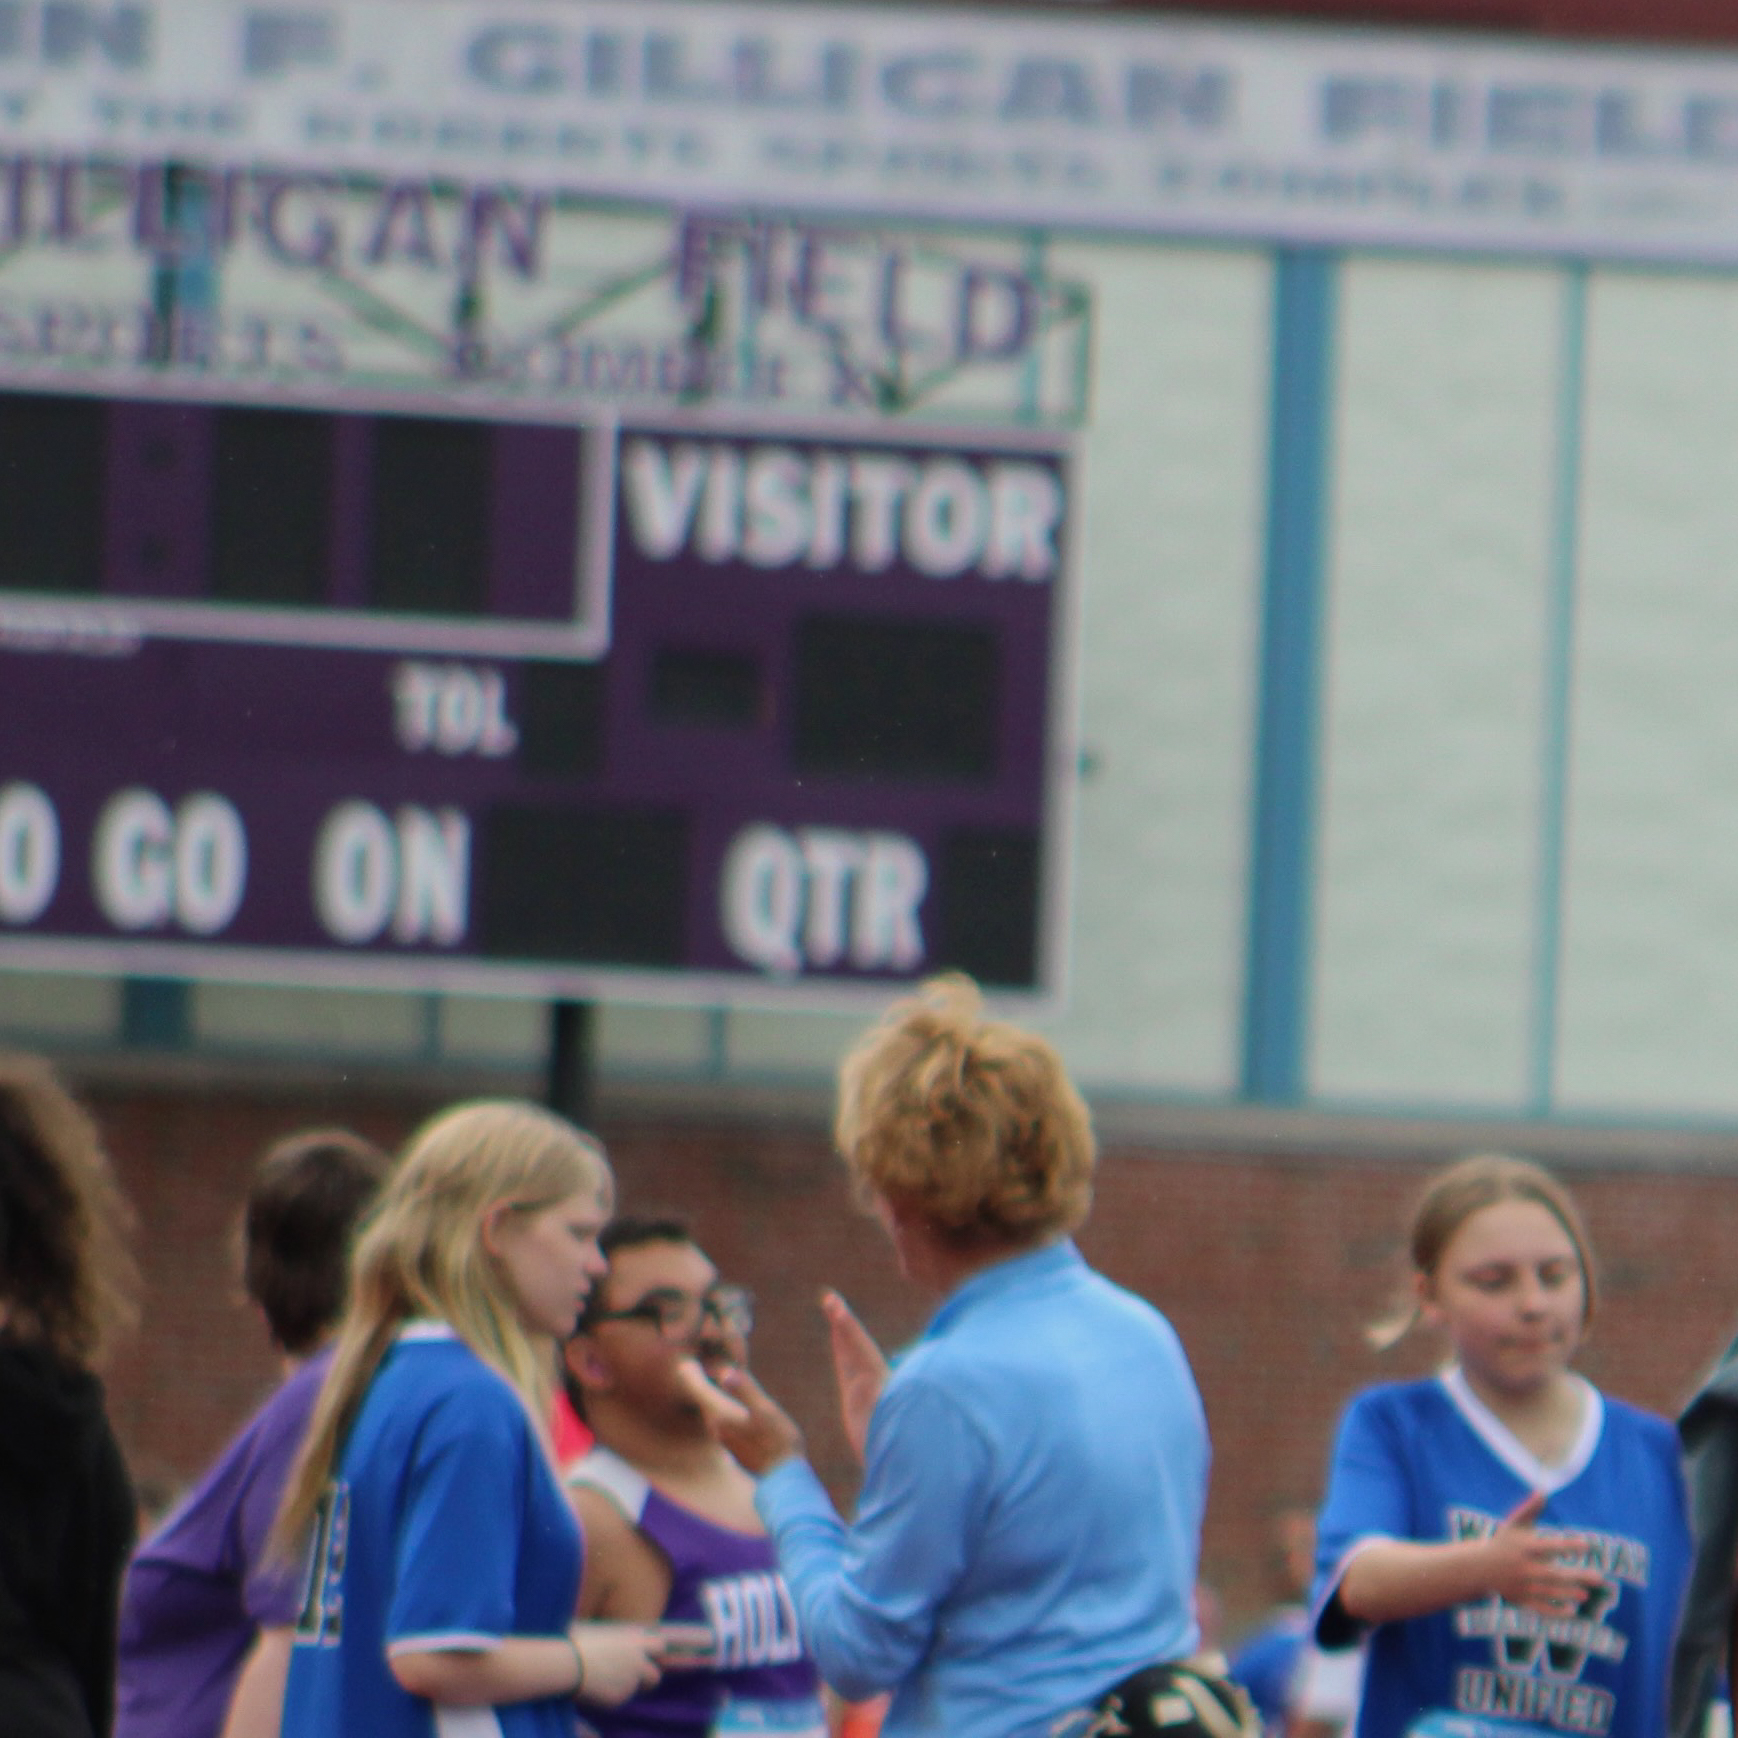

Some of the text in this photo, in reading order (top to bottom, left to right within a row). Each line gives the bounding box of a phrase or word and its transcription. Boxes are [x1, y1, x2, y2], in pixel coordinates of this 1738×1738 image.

[464, 20, 1235, 130] GILLIGAN
[676, 210, 1042, 364] FIELD
[623, 440, 1066, 582] VISITOR
[394, 661, 518, 758] TOL
[93, 788, 248, 938] GO
[313, 797, 472, 948] ON
[720, 822, 930, 982] QTR
[1455, 1665, 1617, 1737] UNIFIED
